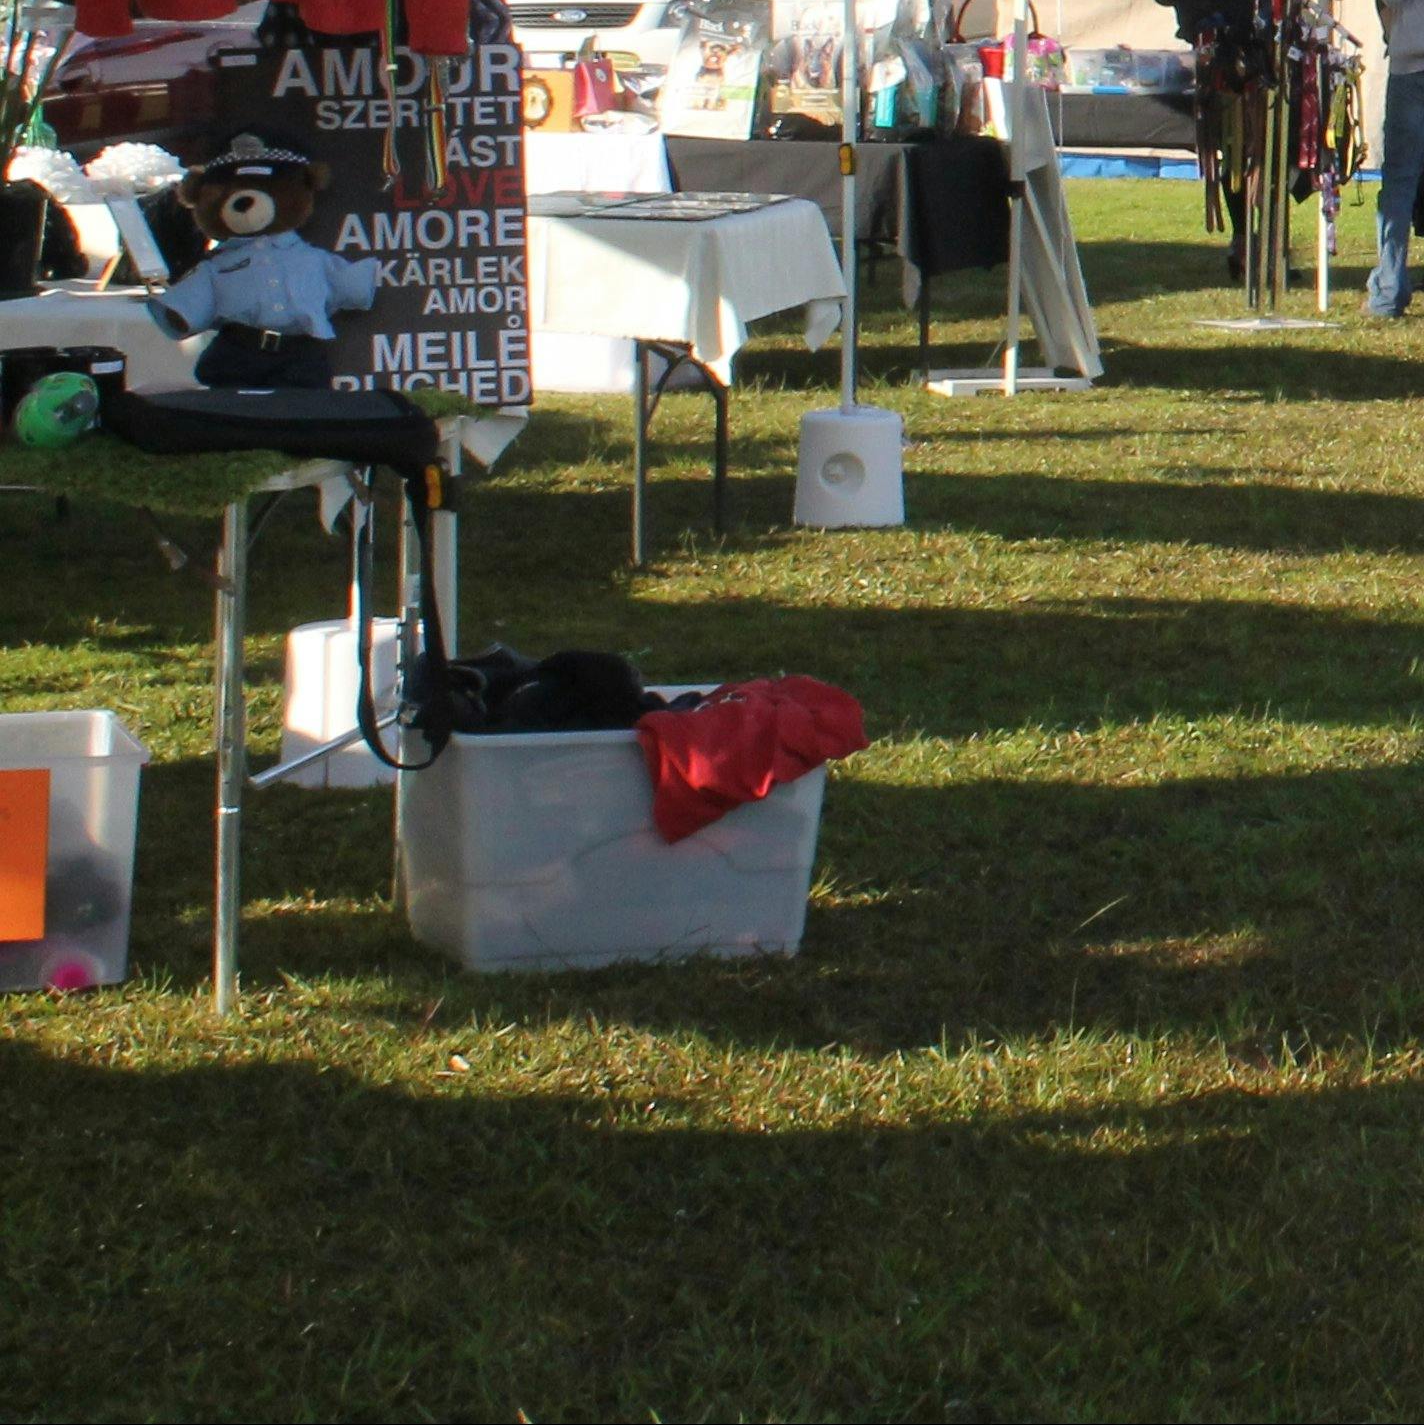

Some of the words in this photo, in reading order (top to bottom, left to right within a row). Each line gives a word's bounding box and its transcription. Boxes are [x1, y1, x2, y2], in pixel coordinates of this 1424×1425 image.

[272, 43, 520, 97] AMOUR
[316, 96, 521, 130] SZERTET
[393, 169, 519, 208] LOVE
[334, 208, 525, 252] AMORE
[375, 253, 524, 287] KÄRLEK
[423, 286, 527, 315] AMOR
